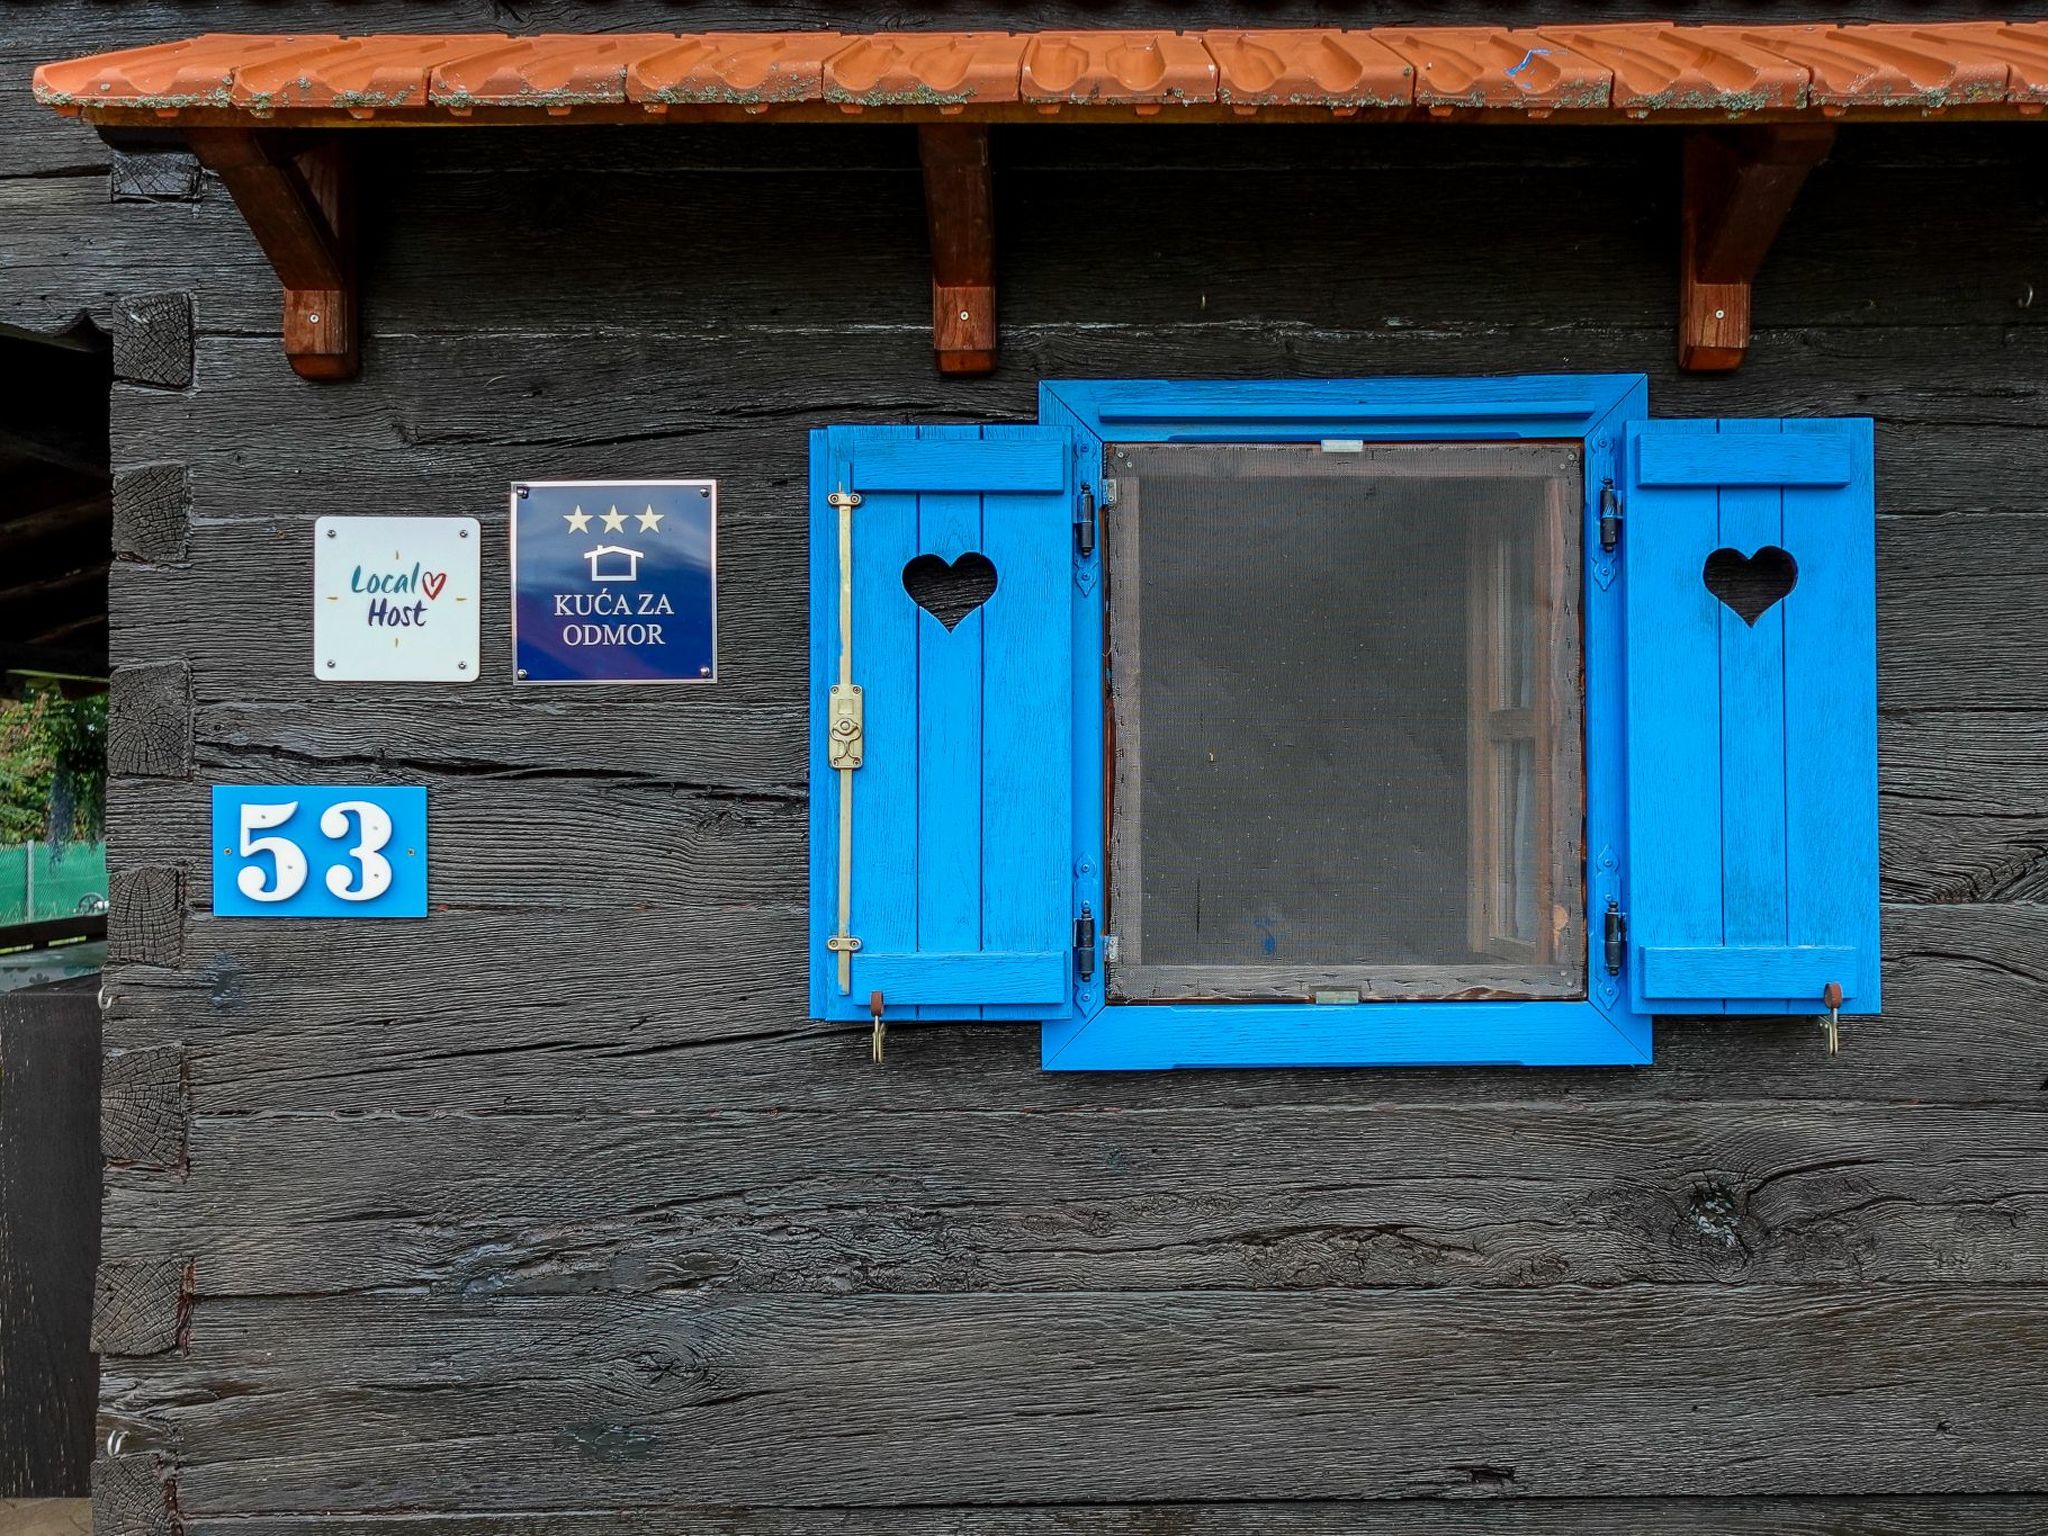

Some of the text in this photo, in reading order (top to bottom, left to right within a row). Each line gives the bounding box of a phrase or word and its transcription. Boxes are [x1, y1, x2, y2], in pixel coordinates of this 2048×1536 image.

[351, 562, 420, 594] Local
[368, 598, 428, 627] Host
[553, 588, 675, 616] KUĆA ZA
[563, 624, 666, 646] ODMOR
[237, 801, 393, 902] 53
